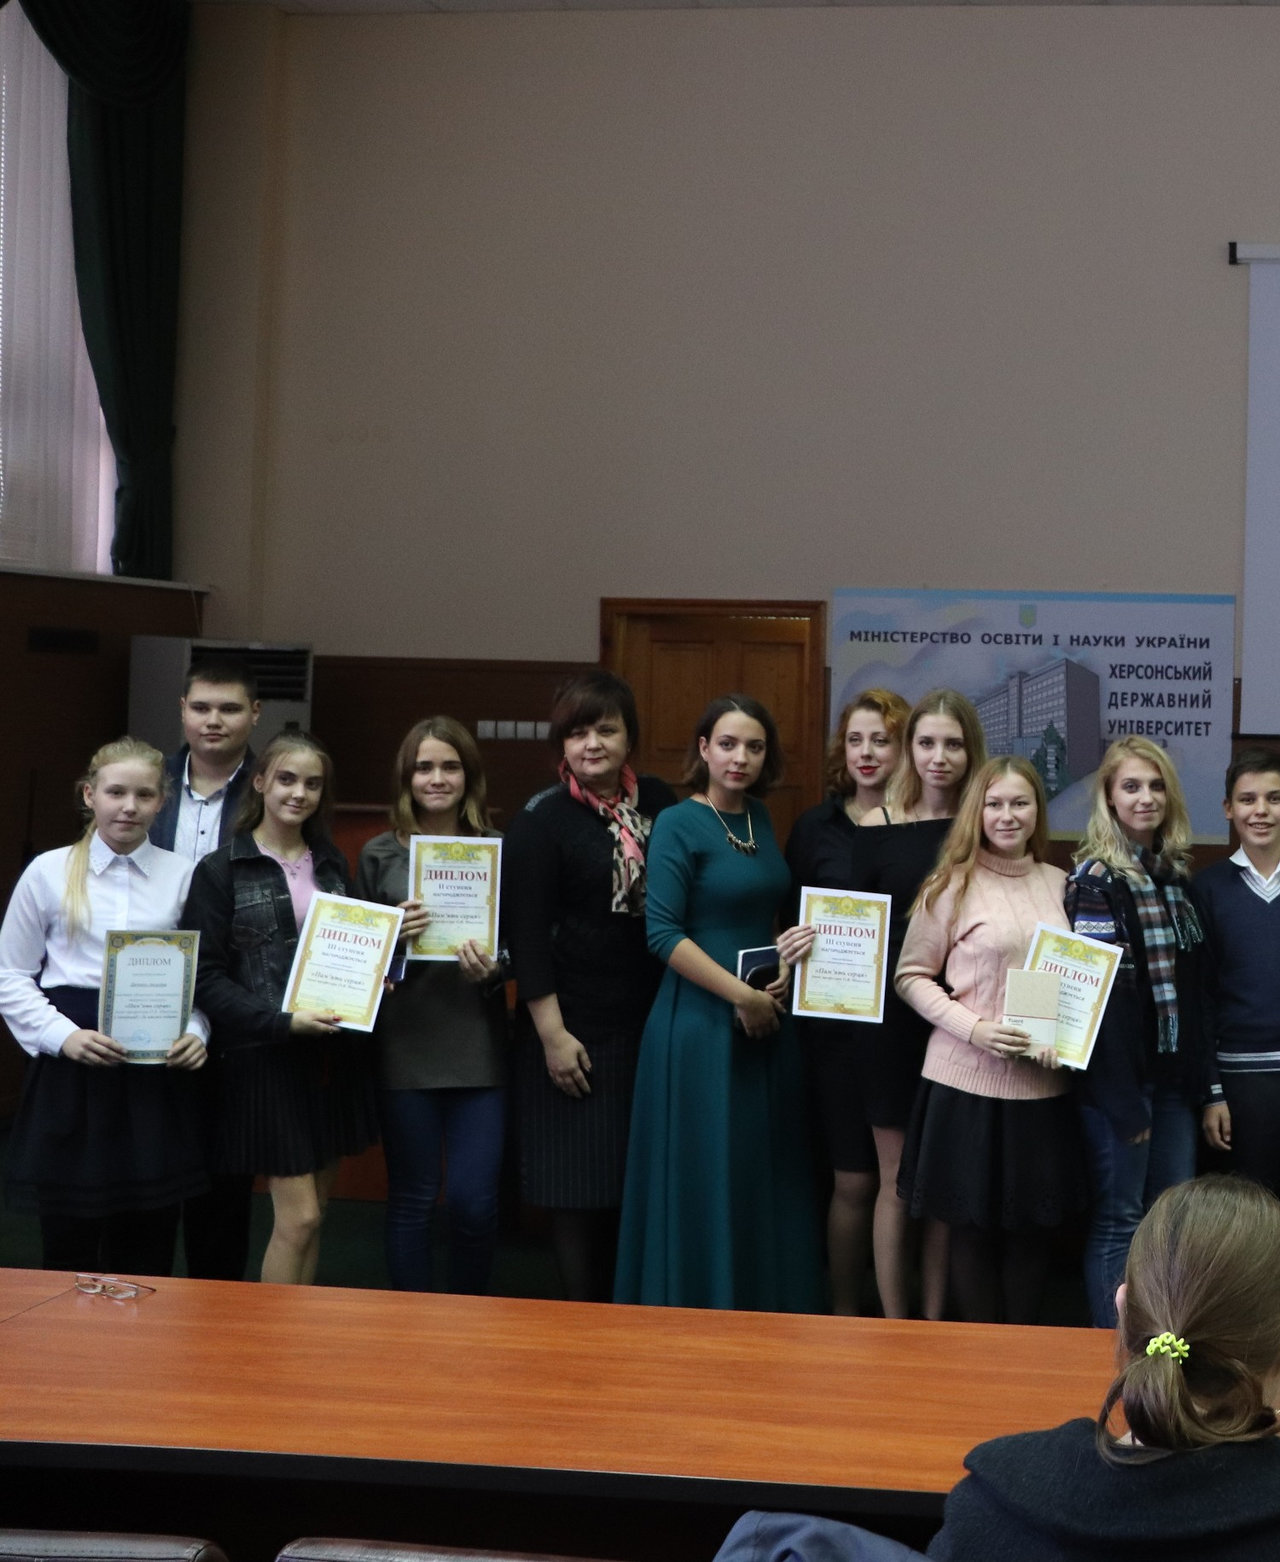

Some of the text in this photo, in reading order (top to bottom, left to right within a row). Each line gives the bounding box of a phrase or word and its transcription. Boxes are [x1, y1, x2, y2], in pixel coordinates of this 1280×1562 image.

[849, 630, 972, 645] МІНІСТЕРСТВО
[981, 632, 1043, 646] ОСВІТИ
[1069, 634, 1126, 648] НАУКИ
[1135, 633, 1211, 649] УКРАЇНИ
[1108, 661, 1213, 681] ХЕРСОНСЬКИЙ
[1108, 690, 1212, 710] ДЕРЖАВНИЙ
[1108, 719, 1212, 737] УНІВЕРСИТЕТ
[424, 869, 488, 882] ДИПЛОМ
[316, 927, 382, 949] ДИПЛОМ
[816, 924, 876, 939] ДИПЛОМ
[1039, 960, 1101, 987] ДИПЛОМ
